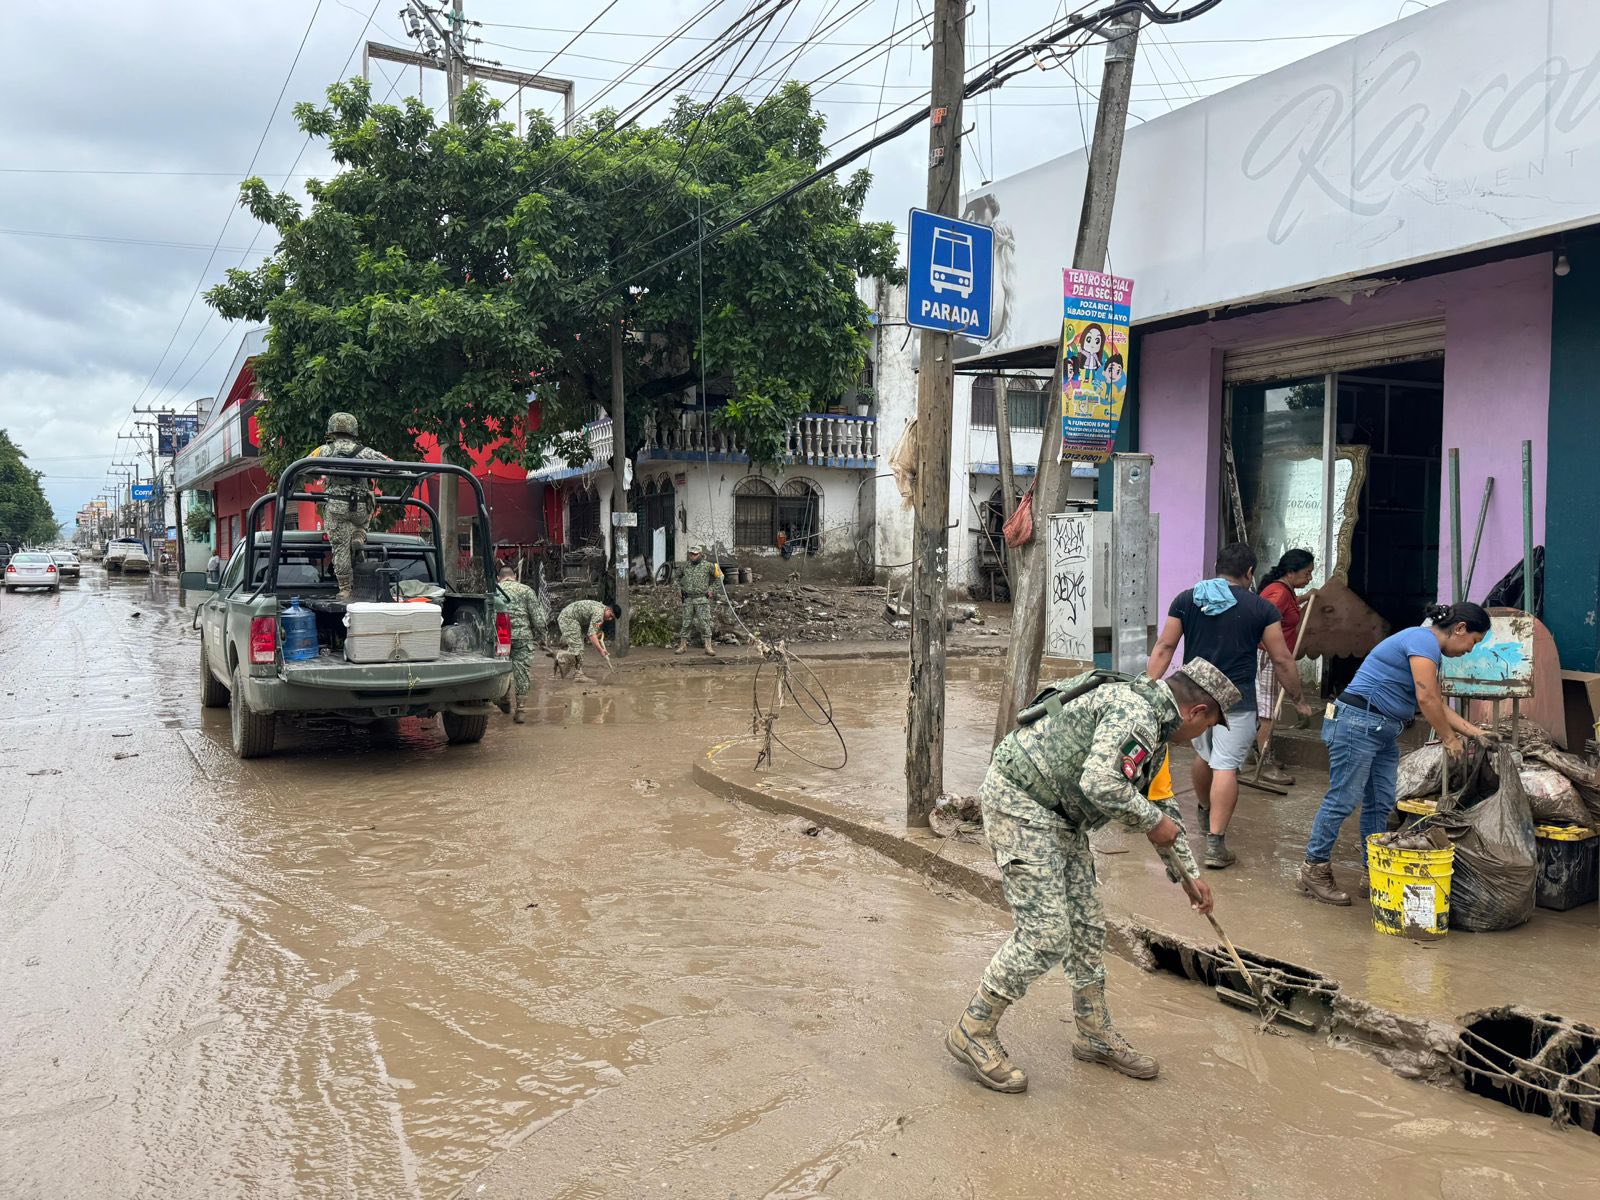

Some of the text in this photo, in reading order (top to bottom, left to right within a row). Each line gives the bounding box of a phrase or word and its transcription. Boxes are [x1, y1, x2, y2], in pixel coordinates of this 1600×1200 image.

[1069, 272, 1128, 291] TEATRO SOCIAL
[1114, 291, 1123, 302] 30
[922, 300, 979, 326] PARADA
[1098, 302, 1113, 311] RICA
